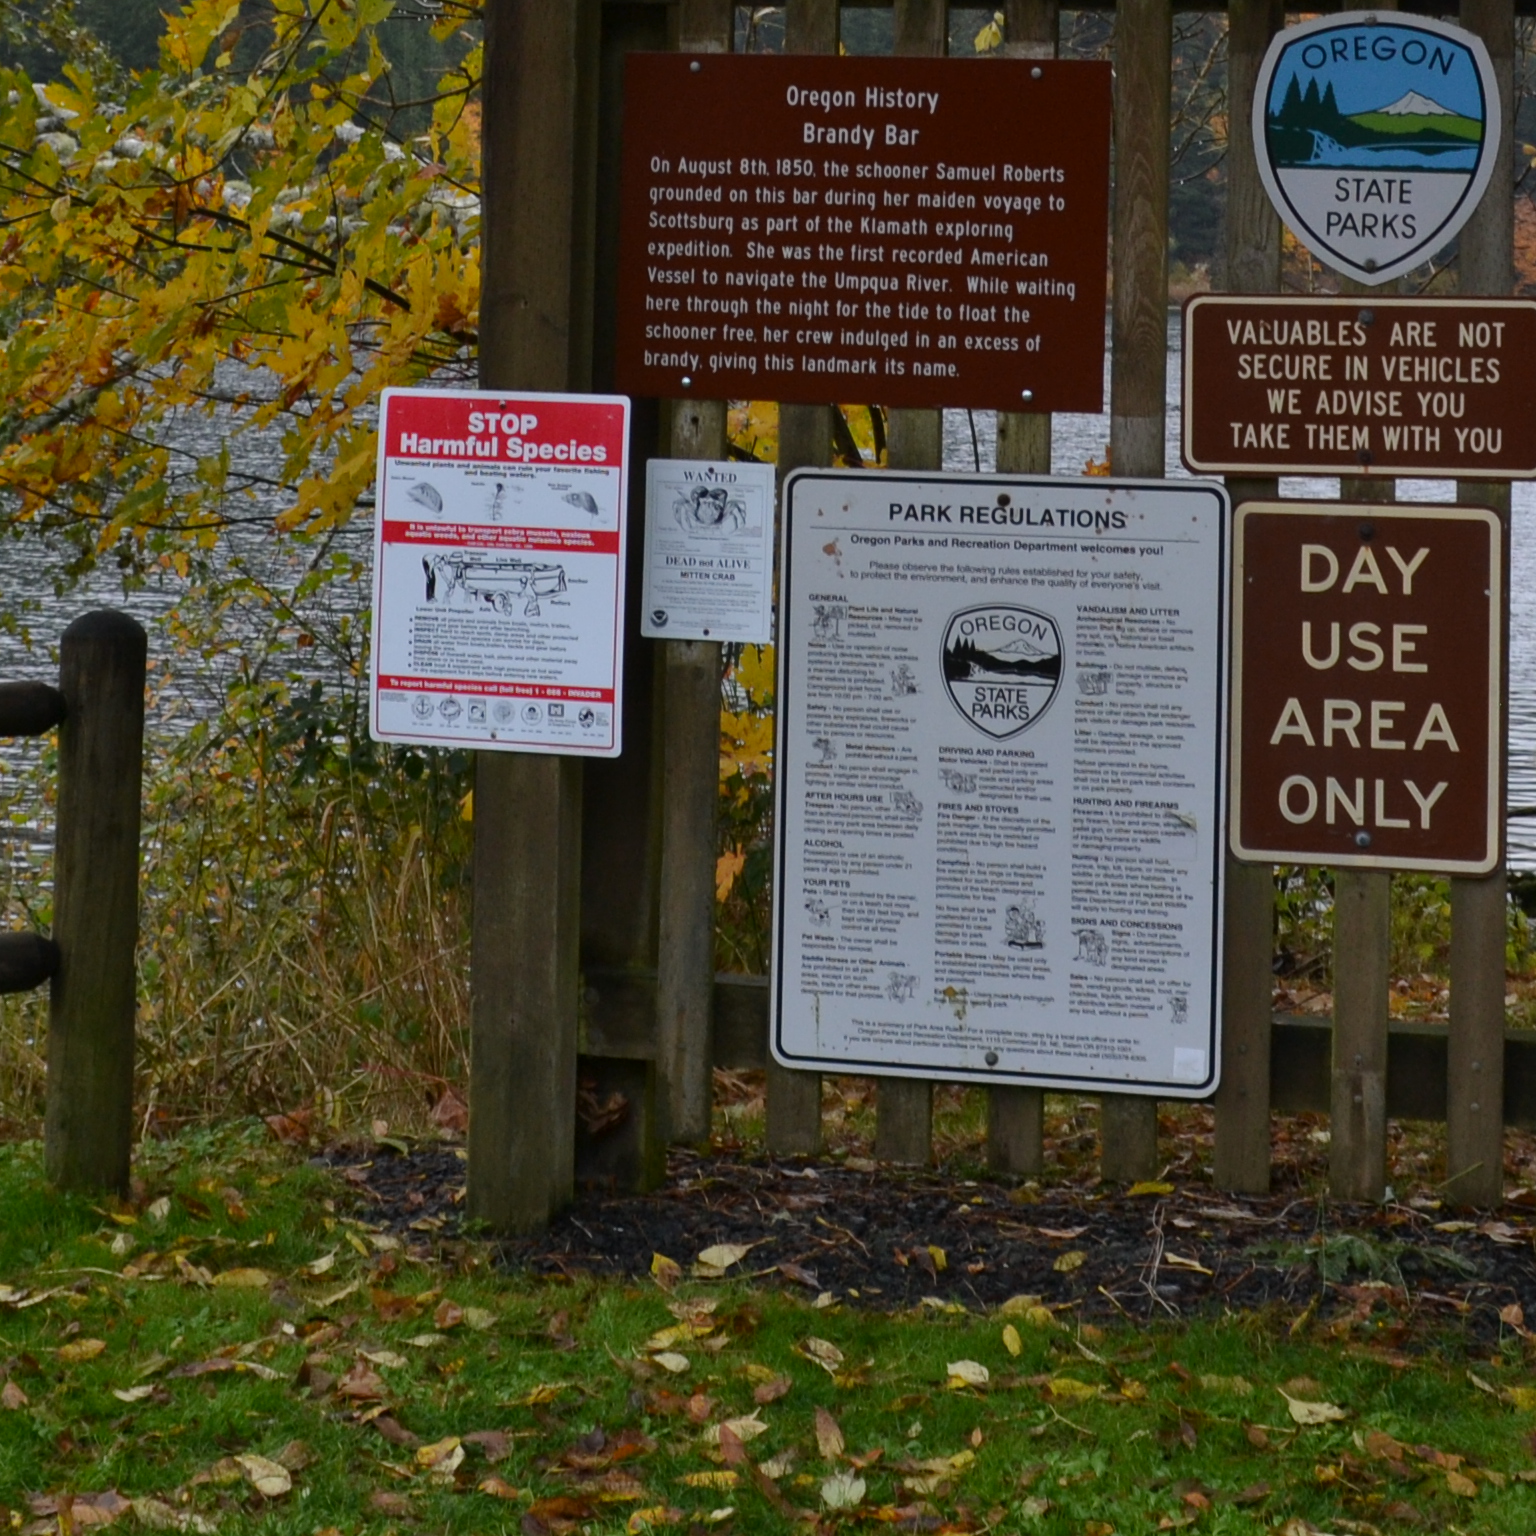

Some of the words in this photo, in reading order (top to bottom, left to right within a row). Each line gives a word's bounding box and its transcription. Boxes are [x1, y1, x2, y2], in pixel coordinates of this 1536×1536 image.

[1302, 36, 1455, 76] OREGON
[787, 86, 855, 112] Oregon
[866, 87, 938, 114] History
[804, 123, 874, 150] Brandy
[886, 125, 919, 145] Bar
[651, 156, 669, 172] On
[678, 157, 731, 178] August
[824, 161, 848, 177] the
[856, 162, 928, 179] schooner
[936, 163, 995, 180] Samuel
[1004, 164, 1064, 182] Roberts
[650, 186, 721, 204] grounded
[730, 189, 747, 202] on
[756, 187, 785, 203] this
[793, 188, 818, 204] bar
[825, 189, 875, 210] during
[884, 190, 909, 206] her
[918, 192, 975, 208] maiden
[984, 196, 1041, 215] voyage
[1049, 195, 1064, 211] to
[1335, 177, 1412, 204] STATE
[649, 211, 733, 234] Scottsburg
[741, 217, 758, 230] as
[767, 216, 797, 235] part
[806, 216, 820, 232] of
[828, 217, 852, 233] the
[861, 217, 927, 234] Klamath
[936, 221, 1012, 242] exploring
[1326, 211, 1417, 239] PARKS
[648, 240, 732, 260] expedition.
[747, 242, 774, 258] She
[782, 247, 811, 259] was
[819, 244, 843, 260] the
[851, 245, 883, 262] first
[893, 248, 962, 264] recorded
[971, 248, 1047, 266] American
[648, 267, 694, 284] Vessel
[703, 269, 717, 284] to
[726, 270, 794, 291] navigate
[802, 272, 826, 288] the
[835, 272, 898, 294] Umpqua
[907, 274, 952, 292] River.
[967, 276, 1008, 293] While
[1016, 279, 1075, 301] waiting
[646, 295, 679, 311] here
[687, 296, 748, 318] through
[756, 298, 781, 314] the
[789, 300, 829, 320] night
[837, 300, 858, 317] for
[866, 302, 890, 318] the
[898, 303, 928, 319] tide
[936, 304, 952, 320] to
[960, 304, 996, 322] float
[1004, 306, 1029, 323] the
[646, 323, 716, 340] schooner
[764, 326, 789, 342] her
[797, 330, 833, 344] crew
[841, 328, 907, 351] indulged
[916, 331, 929, 347] in
[938, 335, 956, 348] an
[965, 336, 1018, 350] excess
[1026, 335, 1040, 351] of
[1227, 320, 1366, 346] VALUABLES
[1390, 322, 1436, 347] ARE
[1459, 322, 1505, 348] NOT
[710, 352, 756, 374] giving
[765, 354, 794, 370] this
[802, 356, 876, 373] landmark
[886, 358, 904, 375] its
[913, 362, 959, 377] name.
[1238, 354, 1332, 381] SECURE
[1346, 356, 1367, 381] IN
[1382, 356, 1500, 383] VEHICLES
[1267, 389, 1302, 415] WE
[1316, 390, 1403, 417] ADVISE
[1417, 392, 1465, 418] YOU
[468, 412, 537, 435] STOP
[400, 433, 498, 457] Harmful
[506, 437, 607, 462] Species
[1230, 423, 1290, 450] TAKE
[1305, 425, 1369, 451] THEM
[1383, 426, 1440, 452] WITH
[1455, 428, 1503, 454] YOU
[683, 471, 737, 483] WANTED
[888, 503, 951, 523] PARK
[960, 505, 1127, 530] REGULATIONS
[851, 534, 891, 547] Oregon
[894, 536, 924, 546] Parks
[928, 537, 948, 547] and
[951, 538, 1010, 549] Recreation
[1014, 540, 1077, 553] Department
[1080, 543, 1135, 554] welcomes
[1139, 546, 1164, 556] you!
[665, 556, 696, 567] DEAD
[699, 559, 714, 567] not
[717, 558, 751, 569] ALIVE
[869, 561, 899, 570] Please
[902, 563, 937, 572] observe
[940, 564, 954, 572] the
[956, 564, 995, 575] following
[999, 567, 1020, 575] rules
[1023, 568, 1074, 577] established
[1076, 570, 1088, 578] for
[1091, 572, 1110, 580] your
[1114, 571, 1143, 581] safety,
[1301, 544, 1430, 595] DAY
[680, 571, 710, 580] MITTEN
[712, 572, 735, 581] CRAB
[861, 572, 891, 580] protect
[894, 572, 908, 580] the
[910, 574, 967, 583] environment,
[970, 575, 987, 584] and
[990, 576, 1028, 585] enhance
[1031, 578, 1045, 586] the
[1048, 579, 1077, 589] quality
[1091, 580, 1139, 590] everyone's
[1142, 582, 1163, 590] visit.
[809, 594, 849, 603] GENERAL
[1077, 605, 1127, 614] VANDALISM
[1129, 606, 1148, 615] AND
[1150, 607, 1180, 616] LITTER
[960, 615, 1047, 640] OREGON
[1302, 621, 1428, 673] USE
[974, 687, 1027, 704] STATE
[972, 702, 1029, 720] PARKS
[1269, 697, 1460, 752] AREA
[938, 746, 974, 756] DRIVING
[976, 748, 994, 756] AND
[996, 749, 1035, 758] PARKING
[805, 792, 832, 800] AFTER
[834, 793, 864, 802] HOURS
[938, 803, 962, 811] FIRES
[965, 804, 983, 812] AND
[985, 805, 1019, 813] STOVES
[1073, 797, 1111, 807] HUNTING
[1115, 798, 1132, 807] AND
[1135, 800, 1179, 810] FIREARMS
[1278, 774, 1449, 829] ONLY
[804, 839, 844, 848] ALCOHOL
[803, 879, 827, 887] YOUR
[829, 880, 850, 888] PETS
[1071, 917, 1097, 926] SIGNS
[1100, 919, 1117, 927] AND
[1120, 920, 1183, 931] CONCESSIONS
